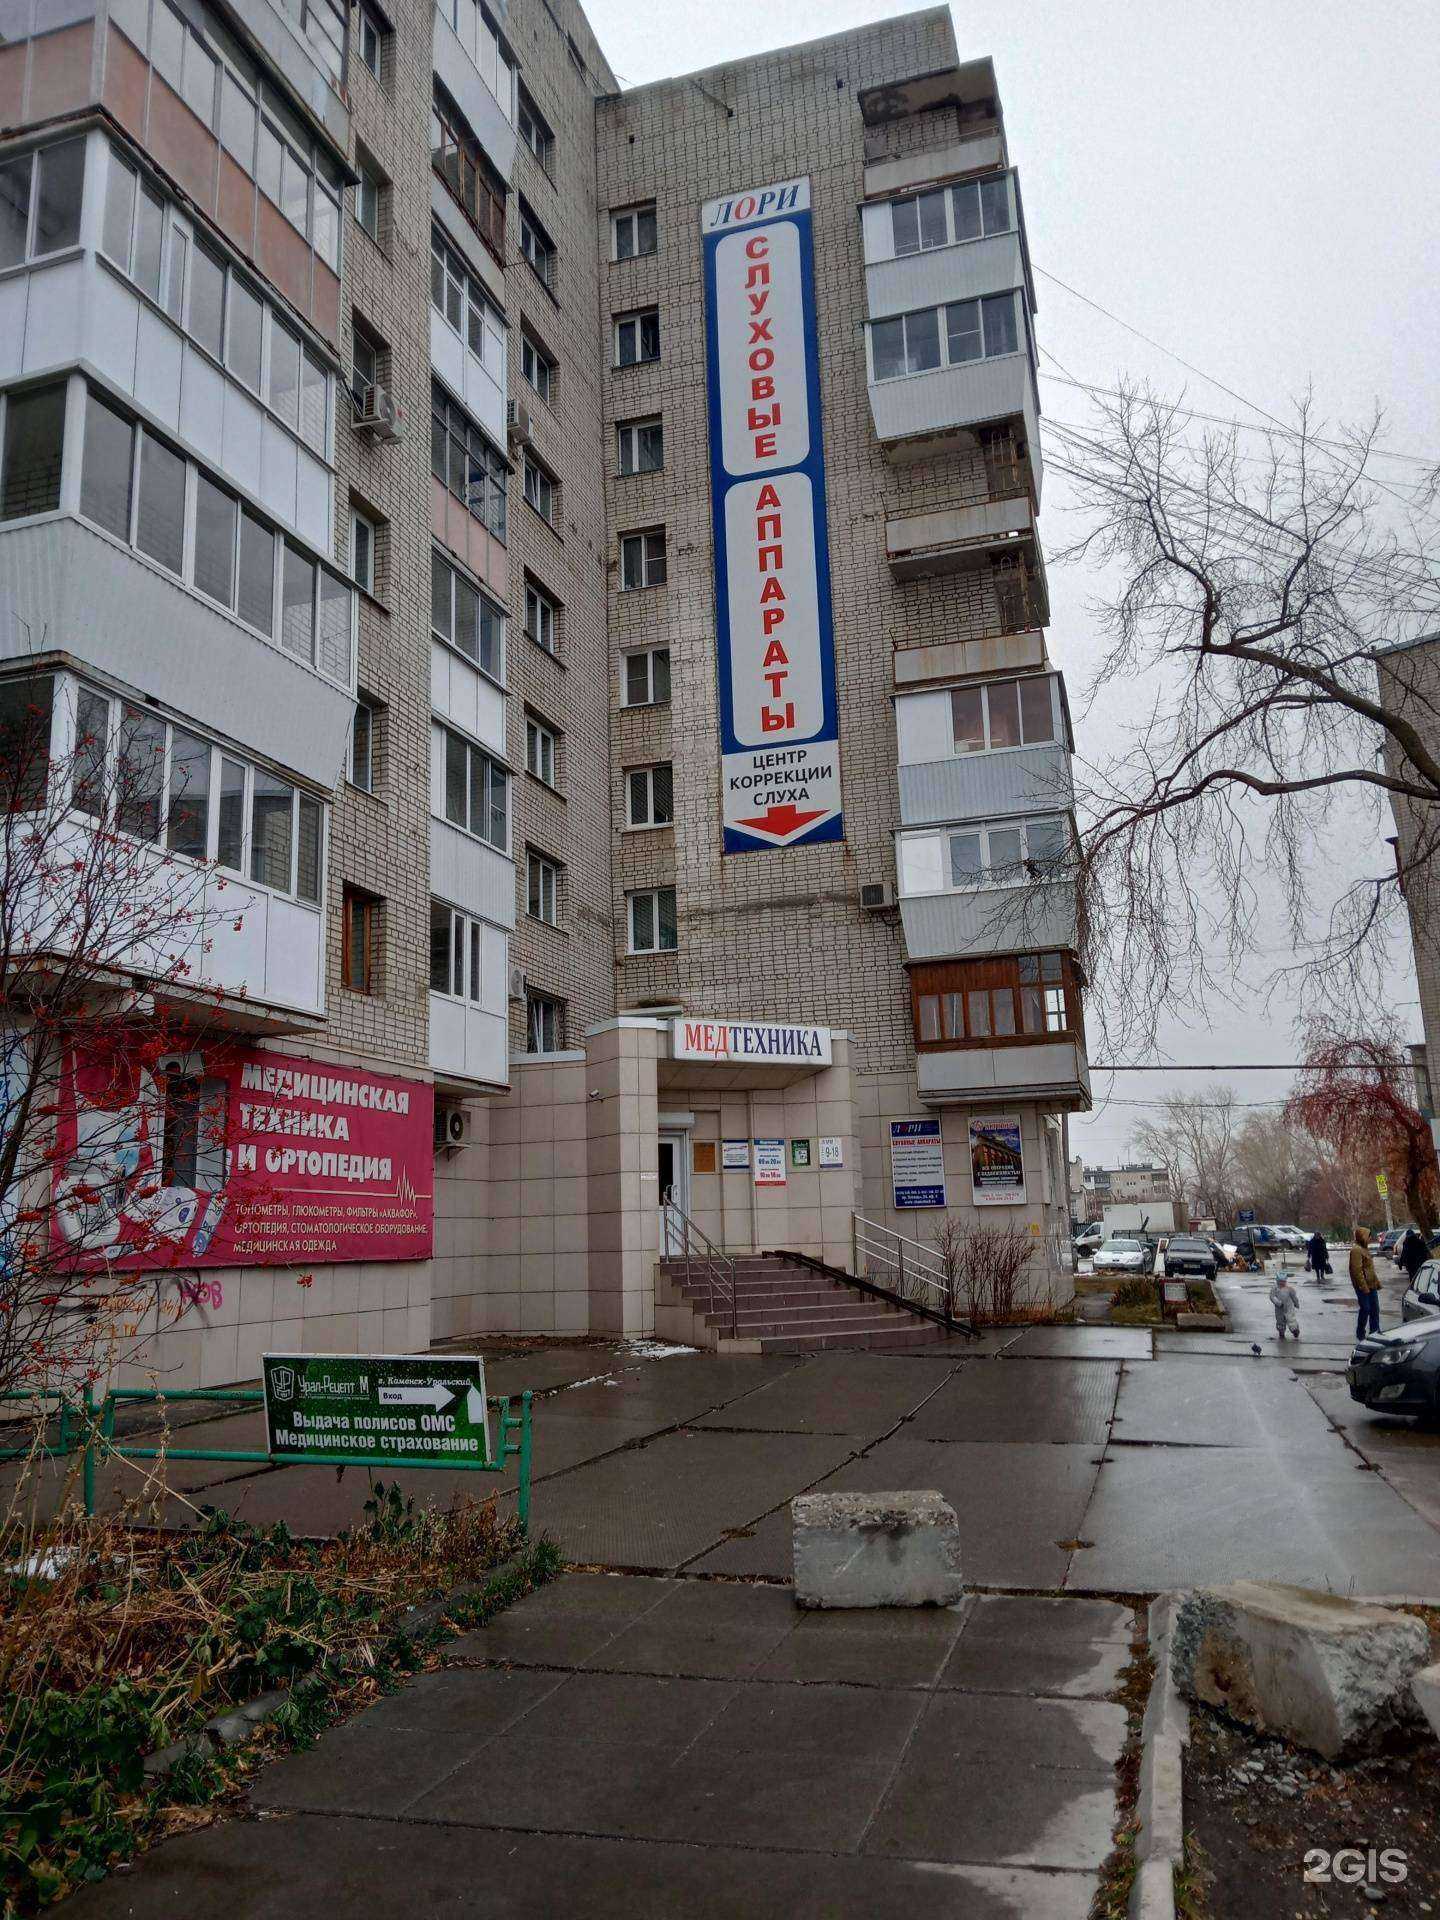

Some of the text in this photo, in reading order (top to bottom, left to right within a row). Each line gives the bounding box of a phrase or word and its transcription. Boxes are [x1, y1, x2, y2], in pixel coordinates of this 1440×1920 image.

[710, 184, 799, 227] ЛОРИ
[744, 235, 781, 459] СЛУХОВЫЕ
[756, 483, 796, 733] АППАРАТЫ
[753, 750, 808, 771] ЦЕНТР
[730, 764, 833, 790] КОРРЕКЦИИ
[753, 787, 810, 806] СЛУХА
[684, 1023, 823, 1058] МЕДТЕХНИКА
[240, 1063, 409, 1115] МЕДИЦИНСКАЯ
[239, 1102, 350, 1141] ТЕХНИКА
[238, 1144, 392, 1182] И ОРТОПЕДИЯ
[235, 1203, 290, 1217] ТОНОМЕТРЫ,
[346, 1206, 378, 1217] ФИЛЬТРЫ
[291, 1222, 373, 1234] СТОМАТОЛОГИЧЕСКОЕ
[233, 1240, 337, 1254] МЕДИЦИНСКАЯ ОДЕЖДА
[383, 1392, 402, 1401] Вход
[293, 1411, 456, 1432] Выдача полисов ОМС
[276, 1429, 478, 1453] Медицинское страхование
